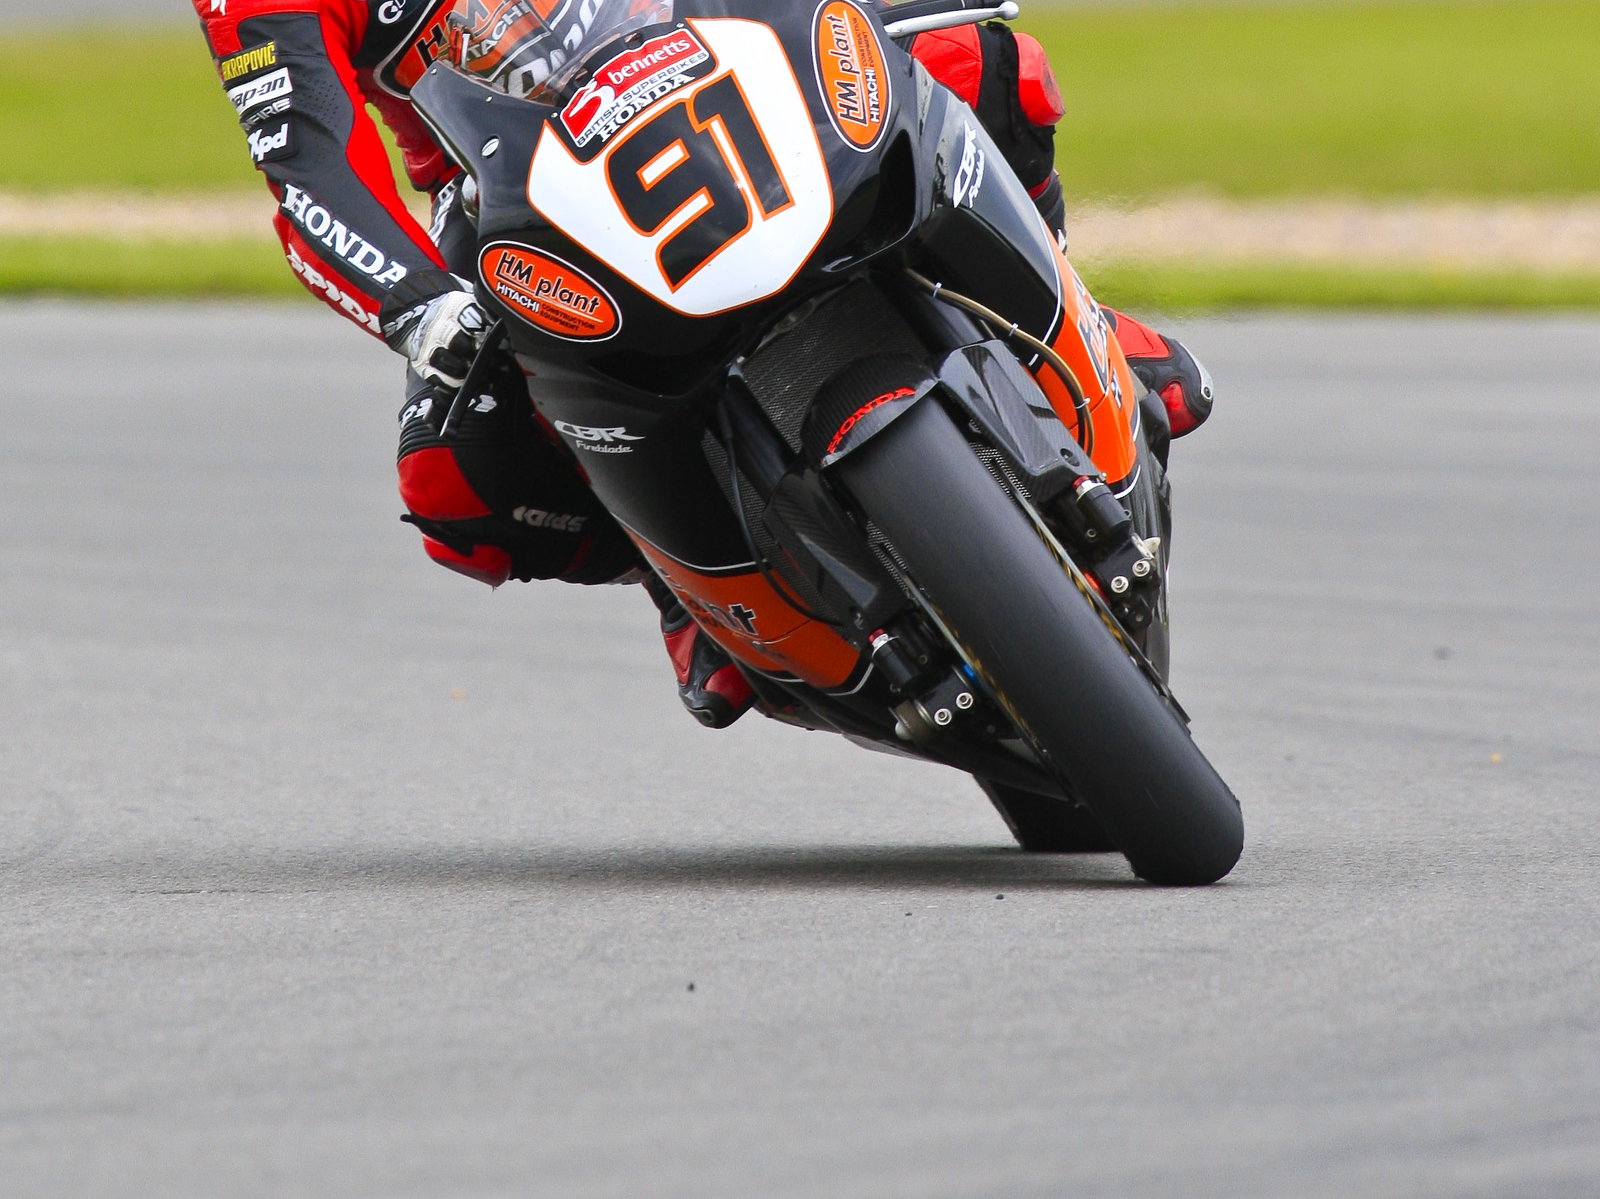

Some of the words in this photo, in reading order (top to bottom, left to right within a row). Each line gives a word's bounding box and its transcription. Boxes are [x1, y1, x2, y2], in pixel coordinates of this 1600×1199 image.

[606, 37, 692, 86] bennetts
[825, 13, 862, 75] plant
[577, 101, 622, 148] BRITISH
[622, 50, 709, 102] SUPERBIKES
[597, 73, 697, 144] HONDA
[837, 78, 863, 126] HM
[865, 68, 880, 124] HITACHI
[603, 68, 797, 295] 91
[280, 182, 408, 290] HONDA
[494, 250, 535, 288] HM
[535, 277, 602, 316] plant
[495, 281, 541, 314] HITACHI
[553, 419, 648, 443] CBR
[826, 386, 917, 455] HONDA
